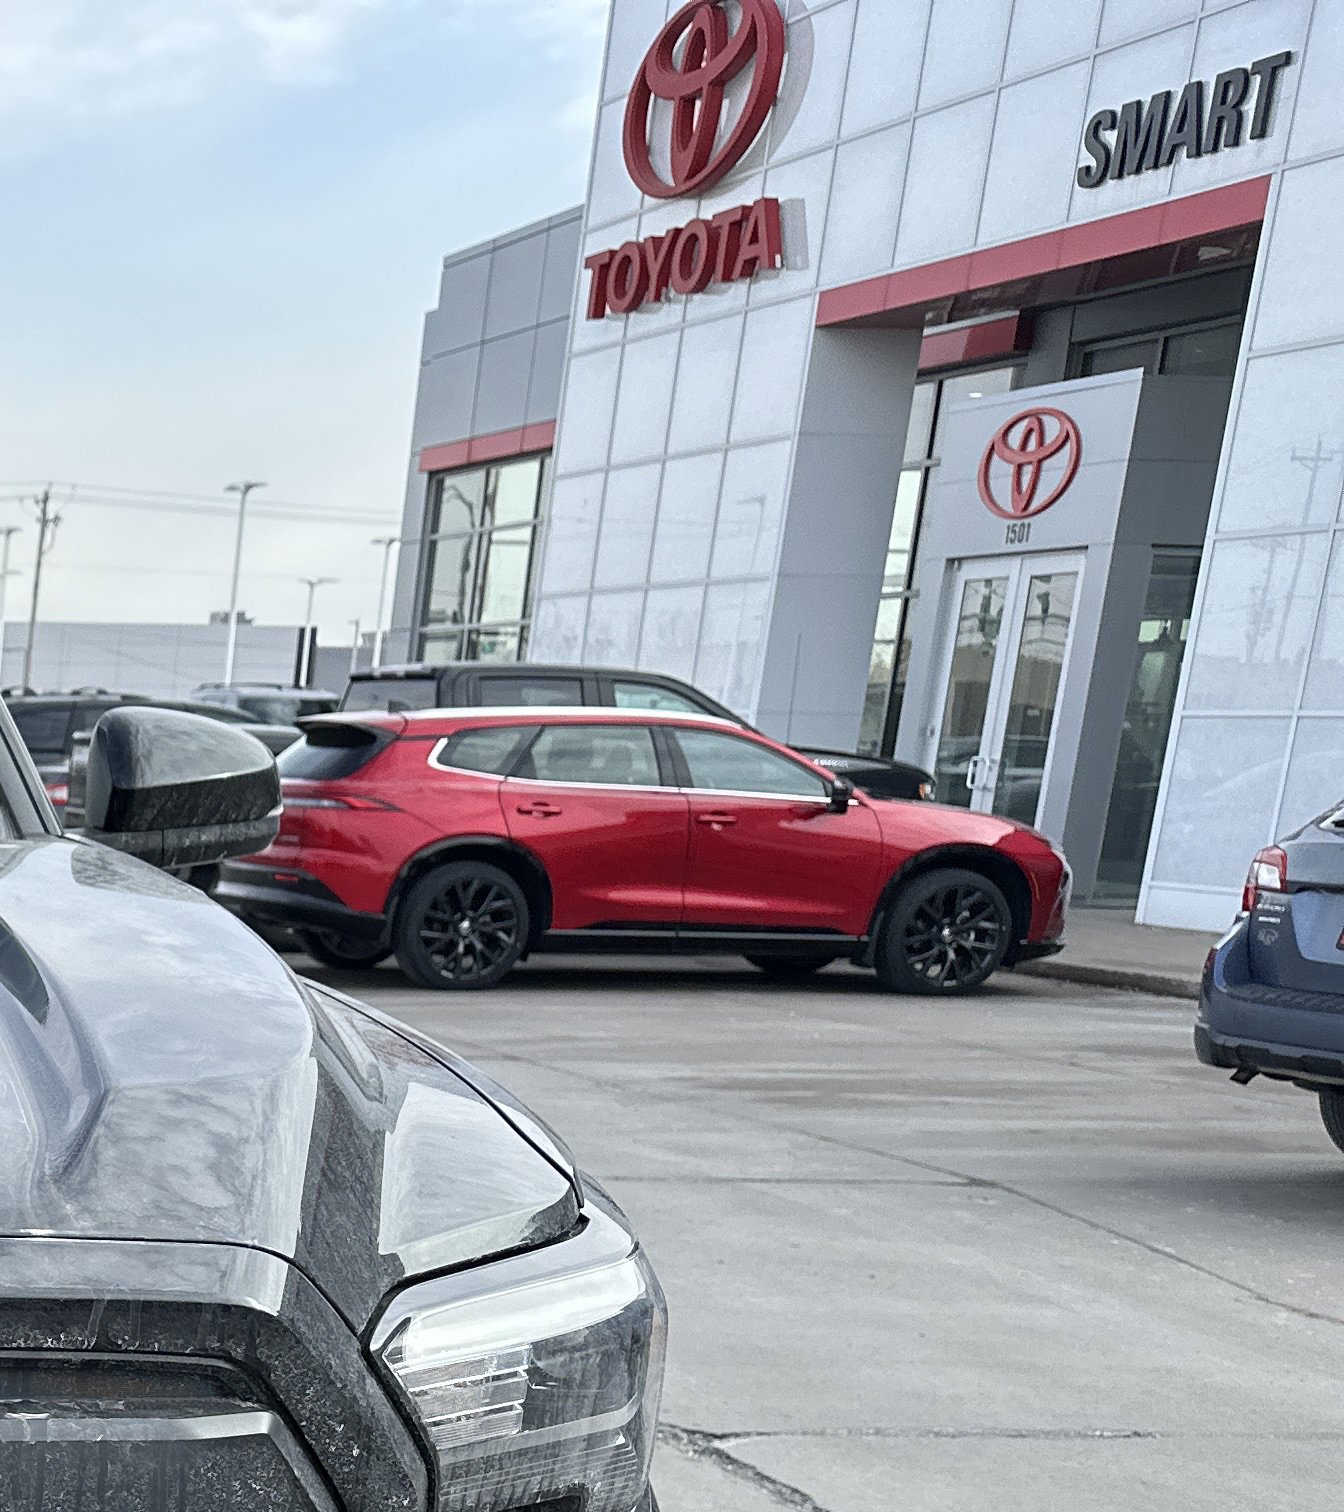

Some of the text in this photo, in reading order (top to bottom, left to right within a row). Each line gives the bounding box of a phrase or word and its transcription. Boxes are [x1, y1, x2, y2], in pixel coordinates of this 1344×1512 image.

[1077, 50, 1292, 188] SMART
[584, 197, 784, 321] TOYOTA
[1005, 522, 1031, 544] 1501
